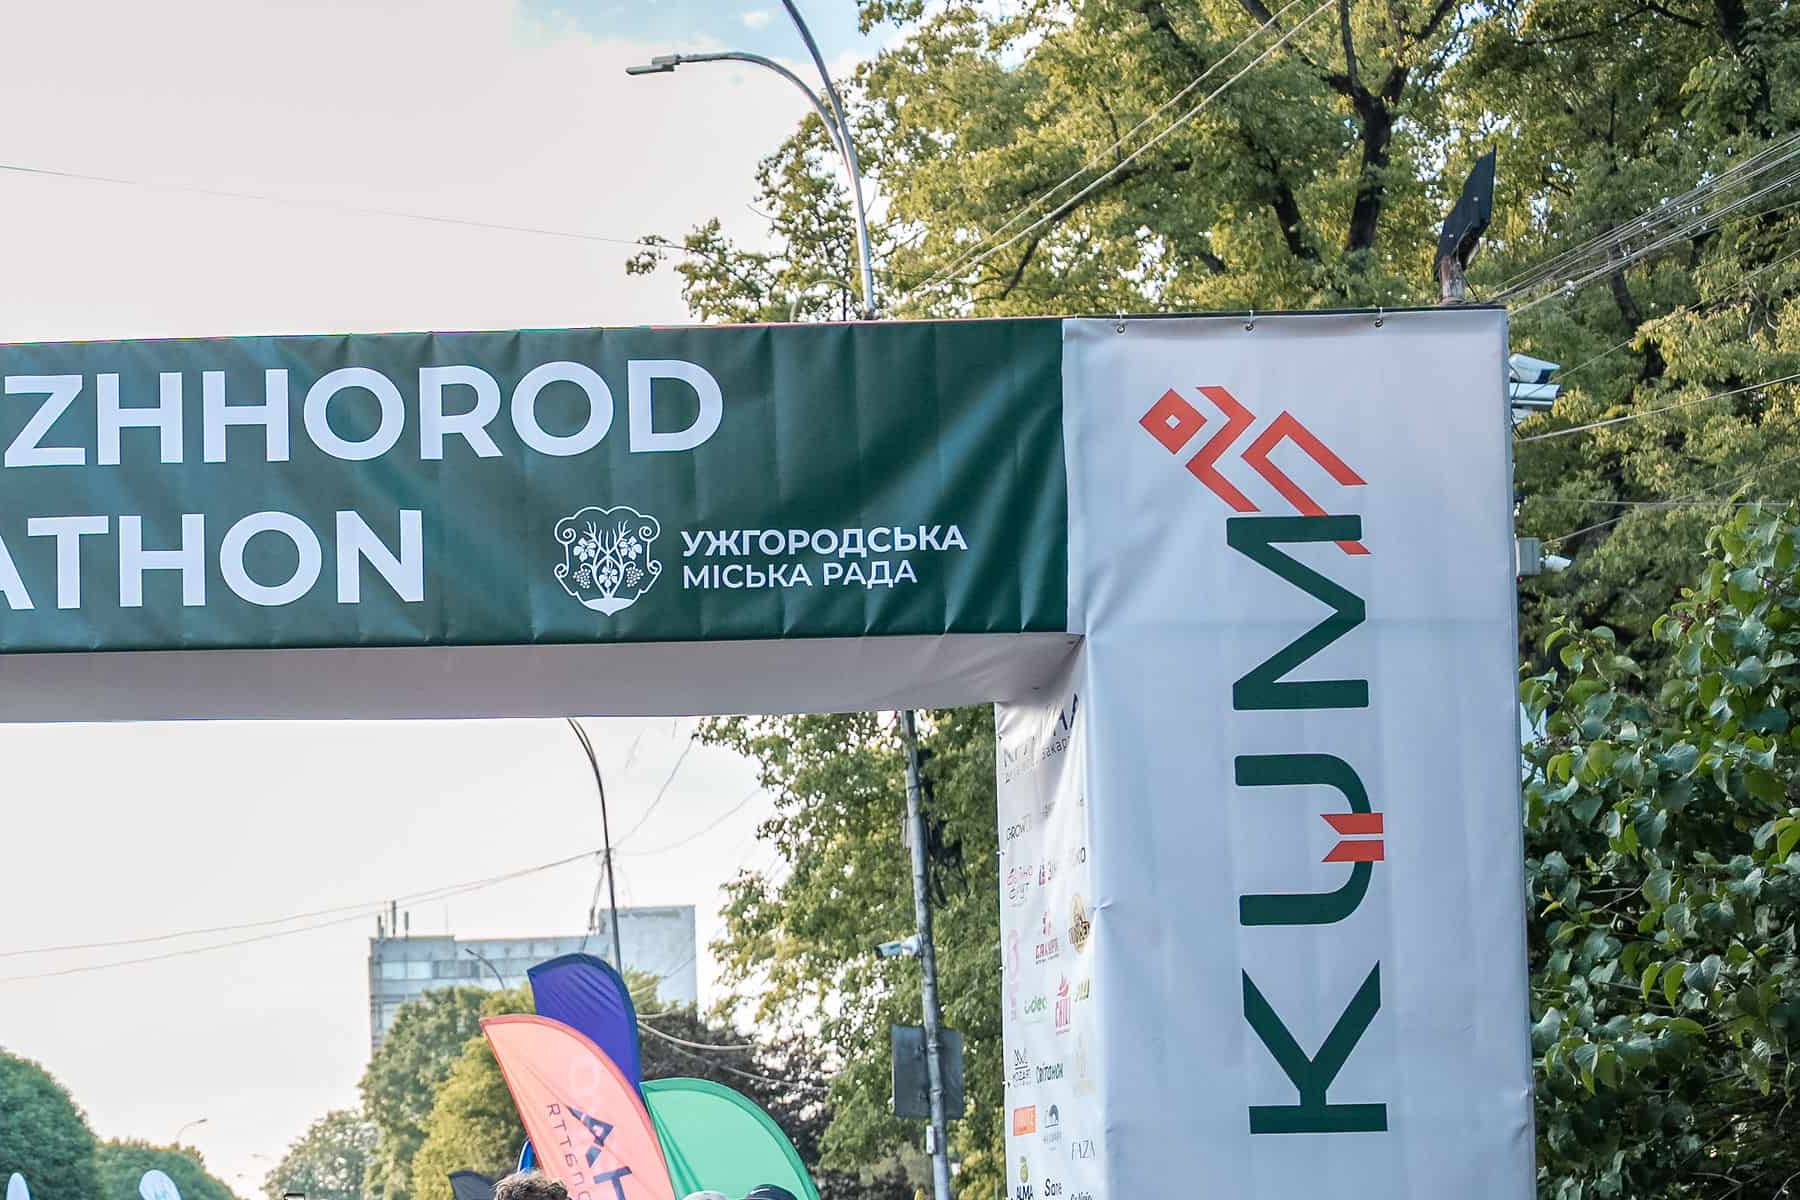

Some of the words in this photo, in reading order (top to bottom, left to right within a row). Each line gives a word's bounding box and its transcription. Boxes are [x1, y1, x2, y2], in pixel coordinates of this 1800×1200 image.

[680, 525, 968, 560] УЖГОРОДСЬКА
[682, 562, 813, 590] МІСЬКА
[823, 559, 918, 589] РАДА
